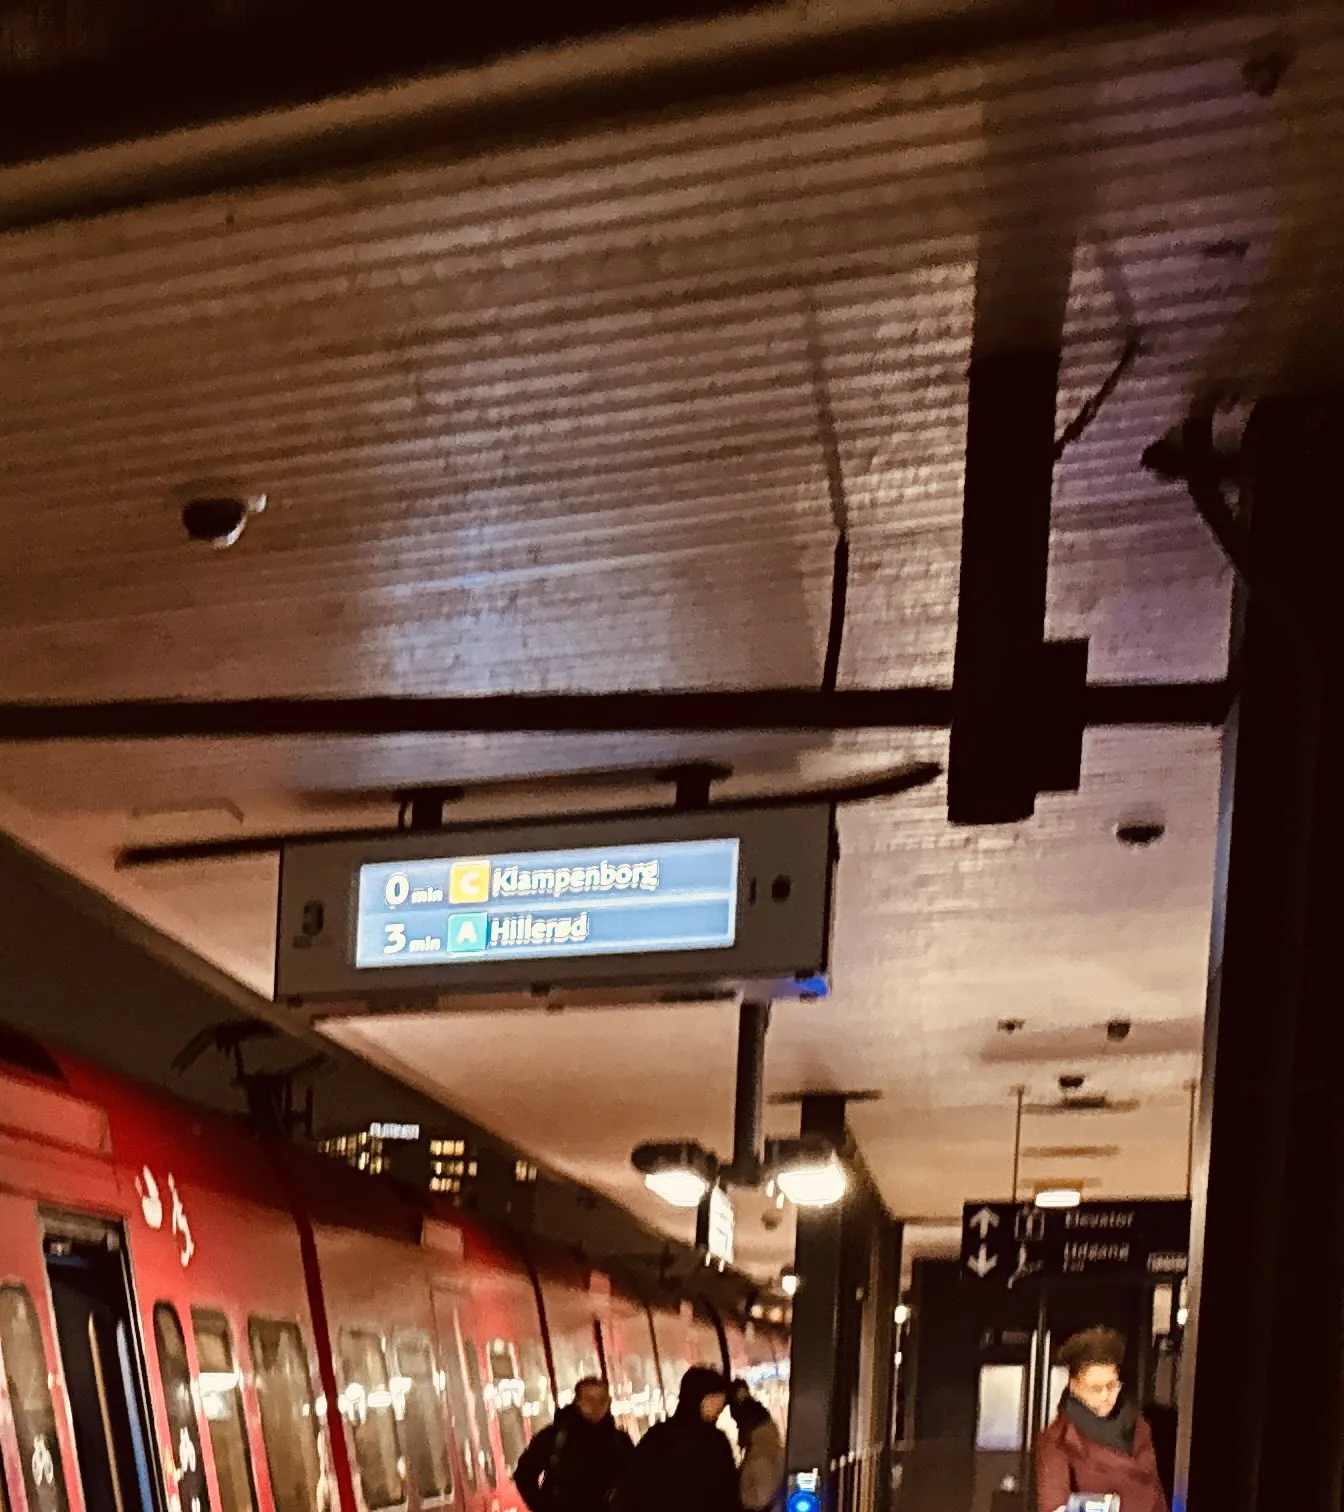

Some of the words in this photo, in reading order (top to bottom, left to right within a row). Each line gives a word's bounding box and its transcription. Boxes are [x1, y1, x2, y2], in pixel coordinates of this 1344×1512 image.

[385, 872, 410, 905] 0
[411, 887, 443, 903] min
[460, 872, 480, 895] C
[492, 860, 659, 897] Klampenborg
[384, 923, 407, 954] 3
[409, 936, 441, 952] min
[456, 920, 477, 944] A
[490, 912, 589, 945] Hillerød
